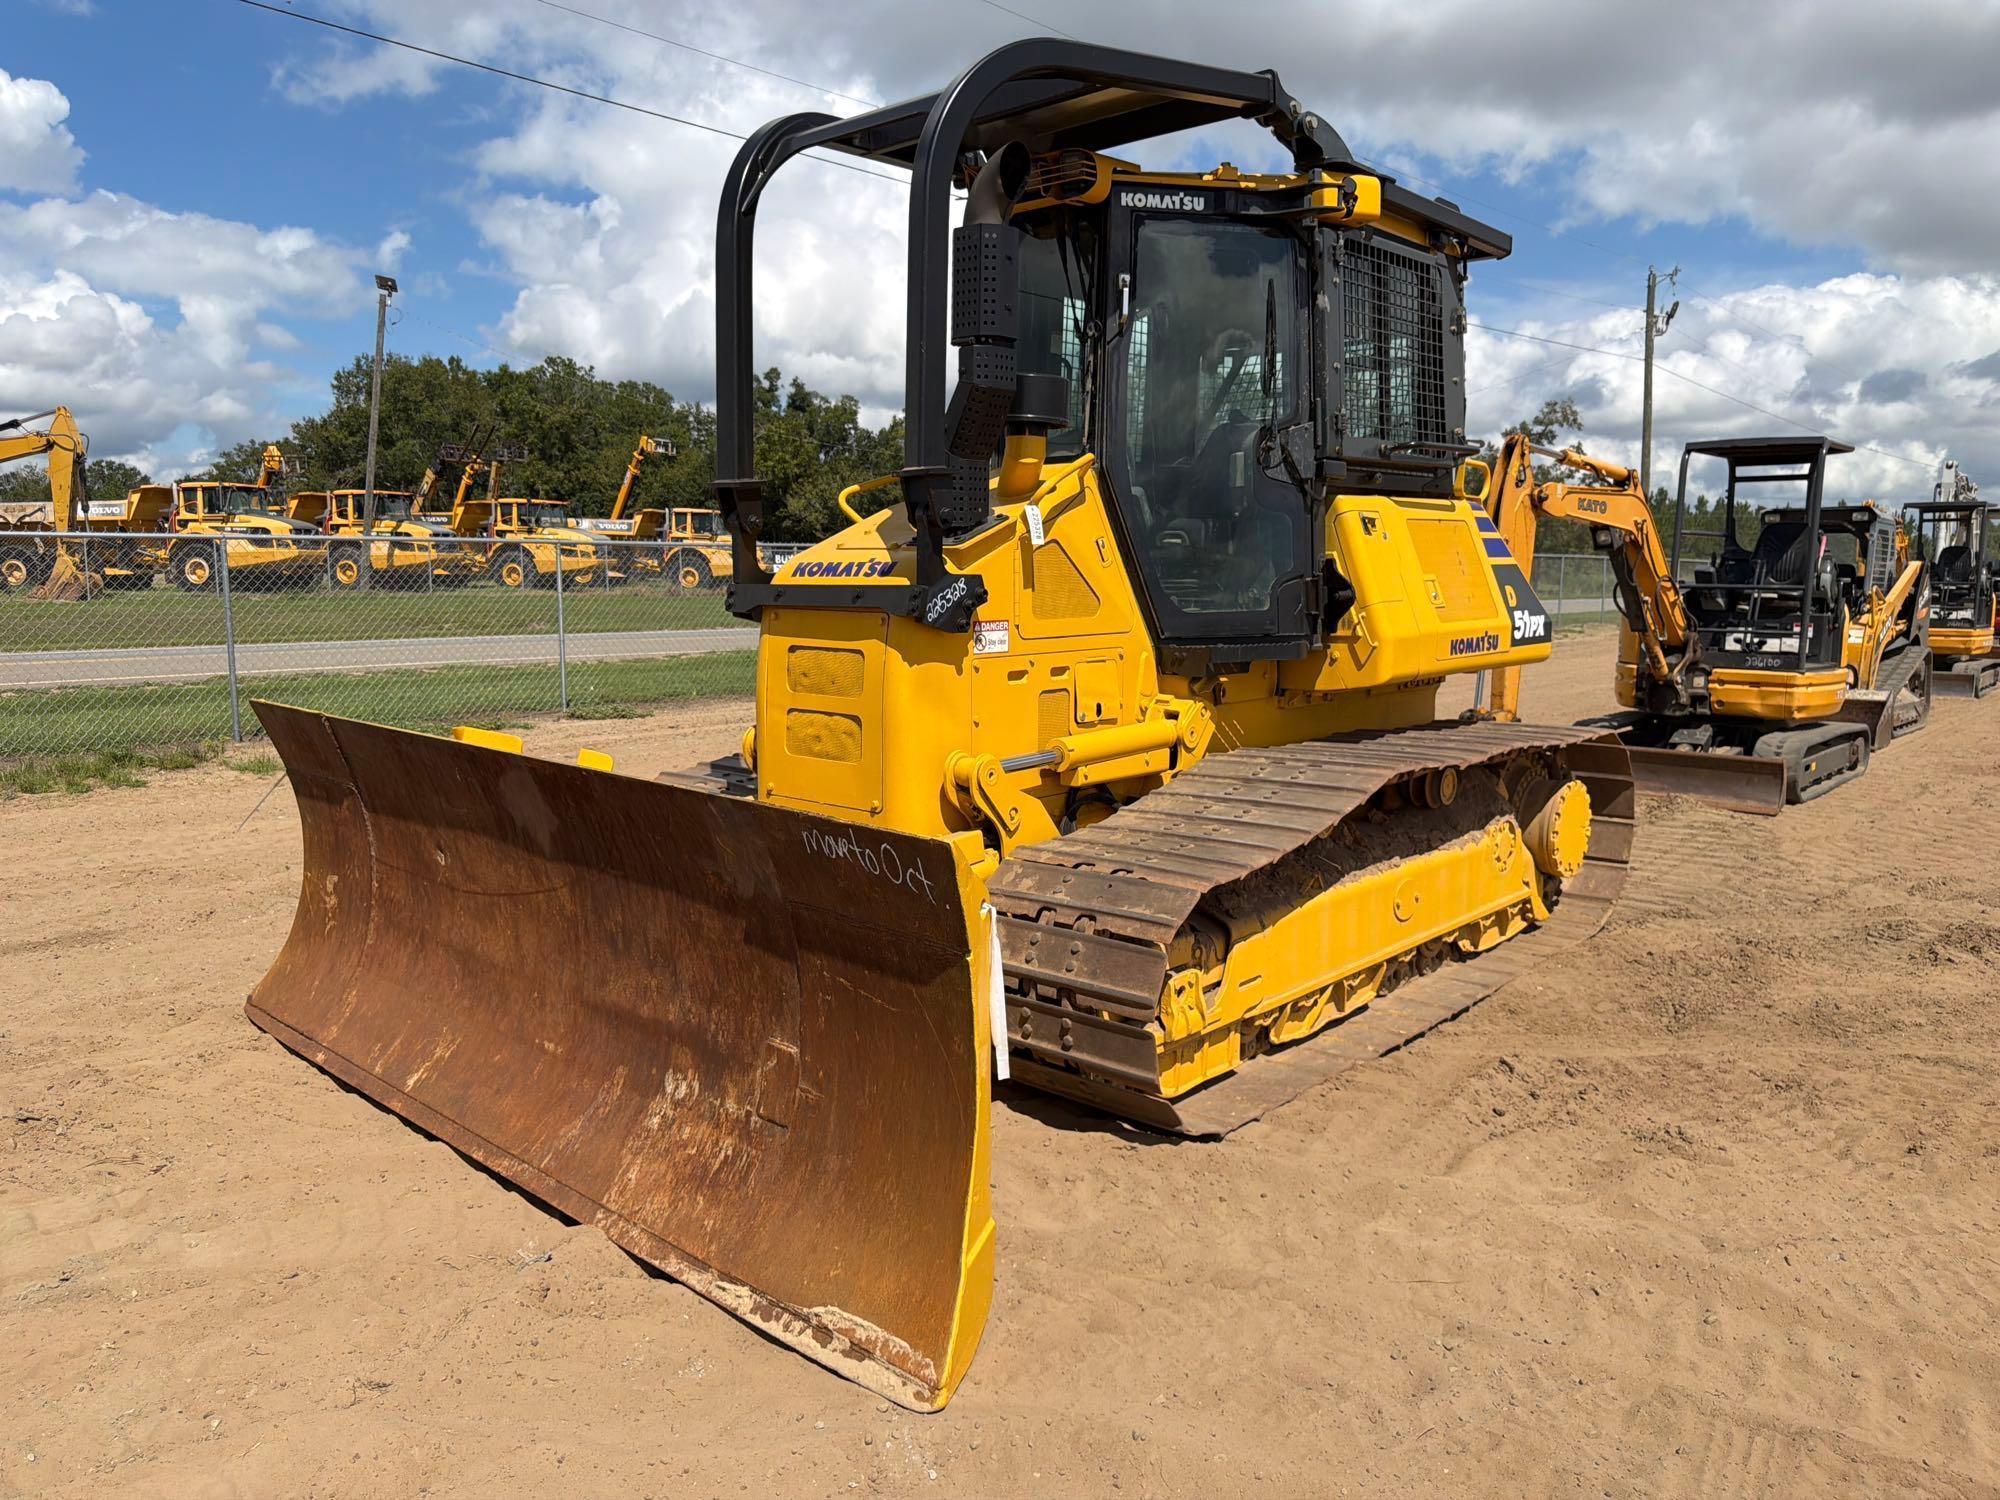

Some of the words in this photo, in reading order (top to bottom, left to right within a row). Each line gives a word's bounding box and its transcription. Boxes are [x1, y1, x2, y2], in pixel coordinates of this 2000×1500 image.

[1120, 192, 1205, 211] KOMATSU
[1577, 497, 1608, 515] KATO
[791, 558, 898, 578] KOMATSU
[926, 577, 968, 622] 225328
[981, 621, 1009, 631] DANGER
[1513, 609, 1545, 640] 51PX
[1450, 630, 1499, 656] KOMATSU
